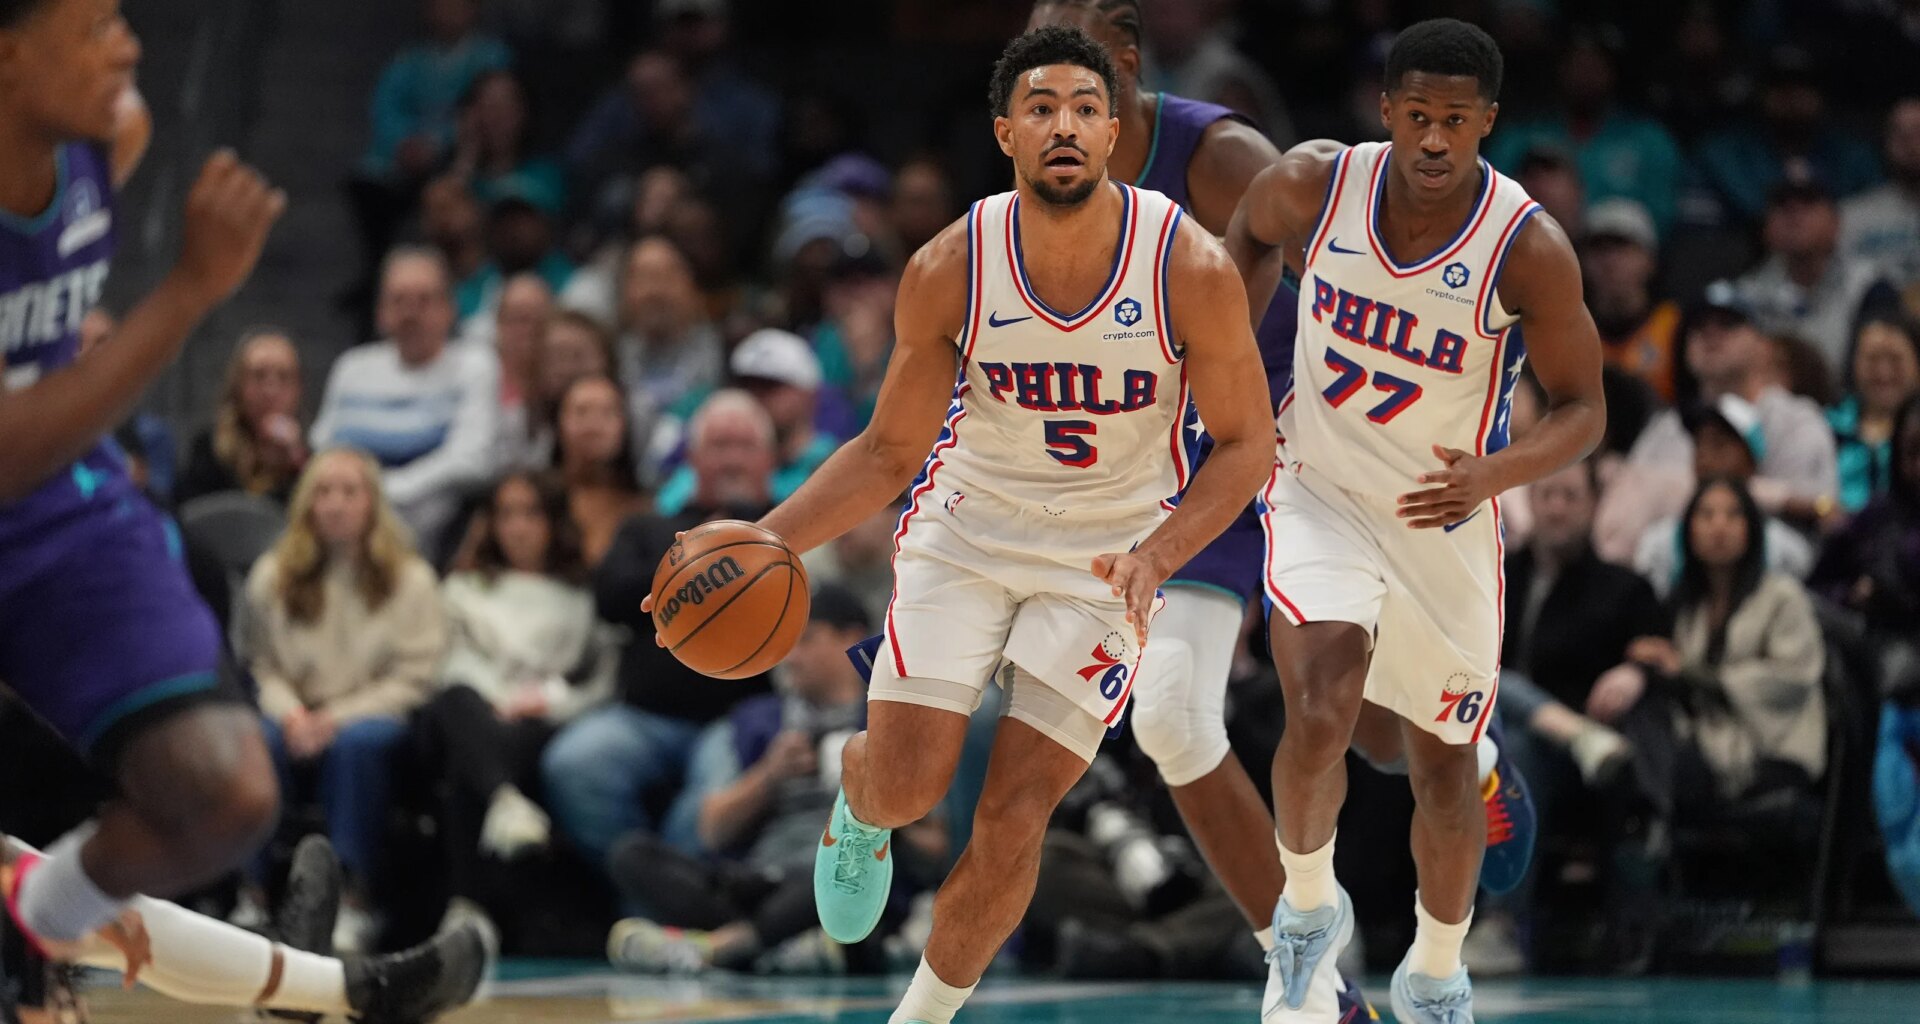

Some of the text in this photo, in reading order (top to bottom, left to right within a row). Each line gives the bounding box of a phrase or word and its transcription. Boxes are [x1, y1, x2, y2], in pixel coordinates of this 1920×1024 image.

[1425, 287, 1475, 306] crypto.com
[1103, 330, 1155, 340] crypto.com
[1312, 274, 1468, 374] PHILA
[978, 361, 1157, 415] PHILA
[1322, 346, 1423, 424] 77
[1044, 420, 1097, 468] 5
[659, 556, 745, 627] Wilson
[1076, 642, 1128, 700] 76
[1434, 689, 1484, 724] 76
